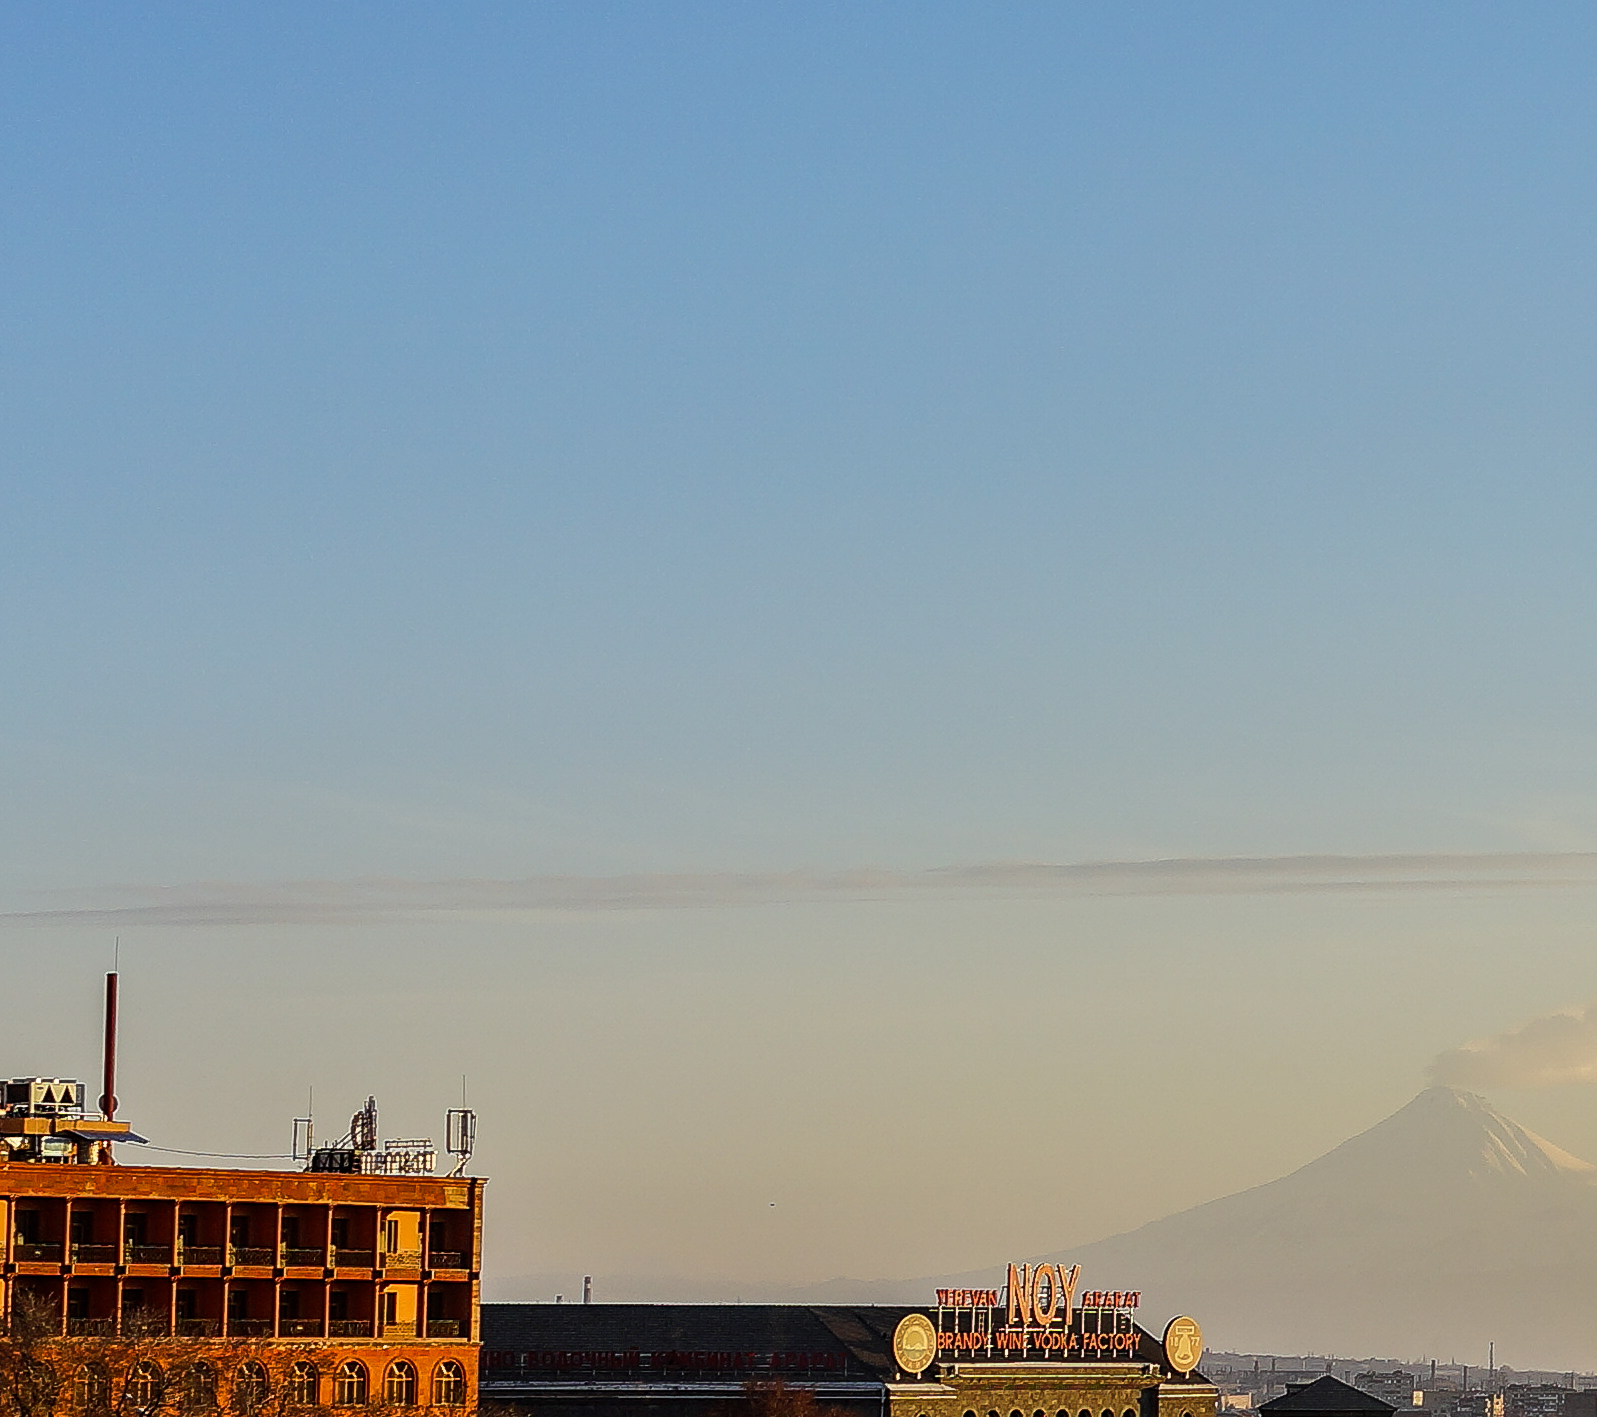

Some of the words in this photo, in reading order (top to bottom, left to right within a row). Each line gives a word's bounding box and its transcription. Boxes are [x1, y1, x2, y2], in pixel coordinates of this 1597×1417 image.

[936, 1289, 998, 1307] YEREVAN
[1083, 1291, 1142, 1308] ARARAT
[1008, 1262, 1082, 1326] NOY
[937, 1332, 990, 1350] BRANDY
[996, 1332, 1029, 1350] WINE
[1034, 1332, 1077, 1350] VODKA
[1083, 1332, 1142, 1350] FACTORY
